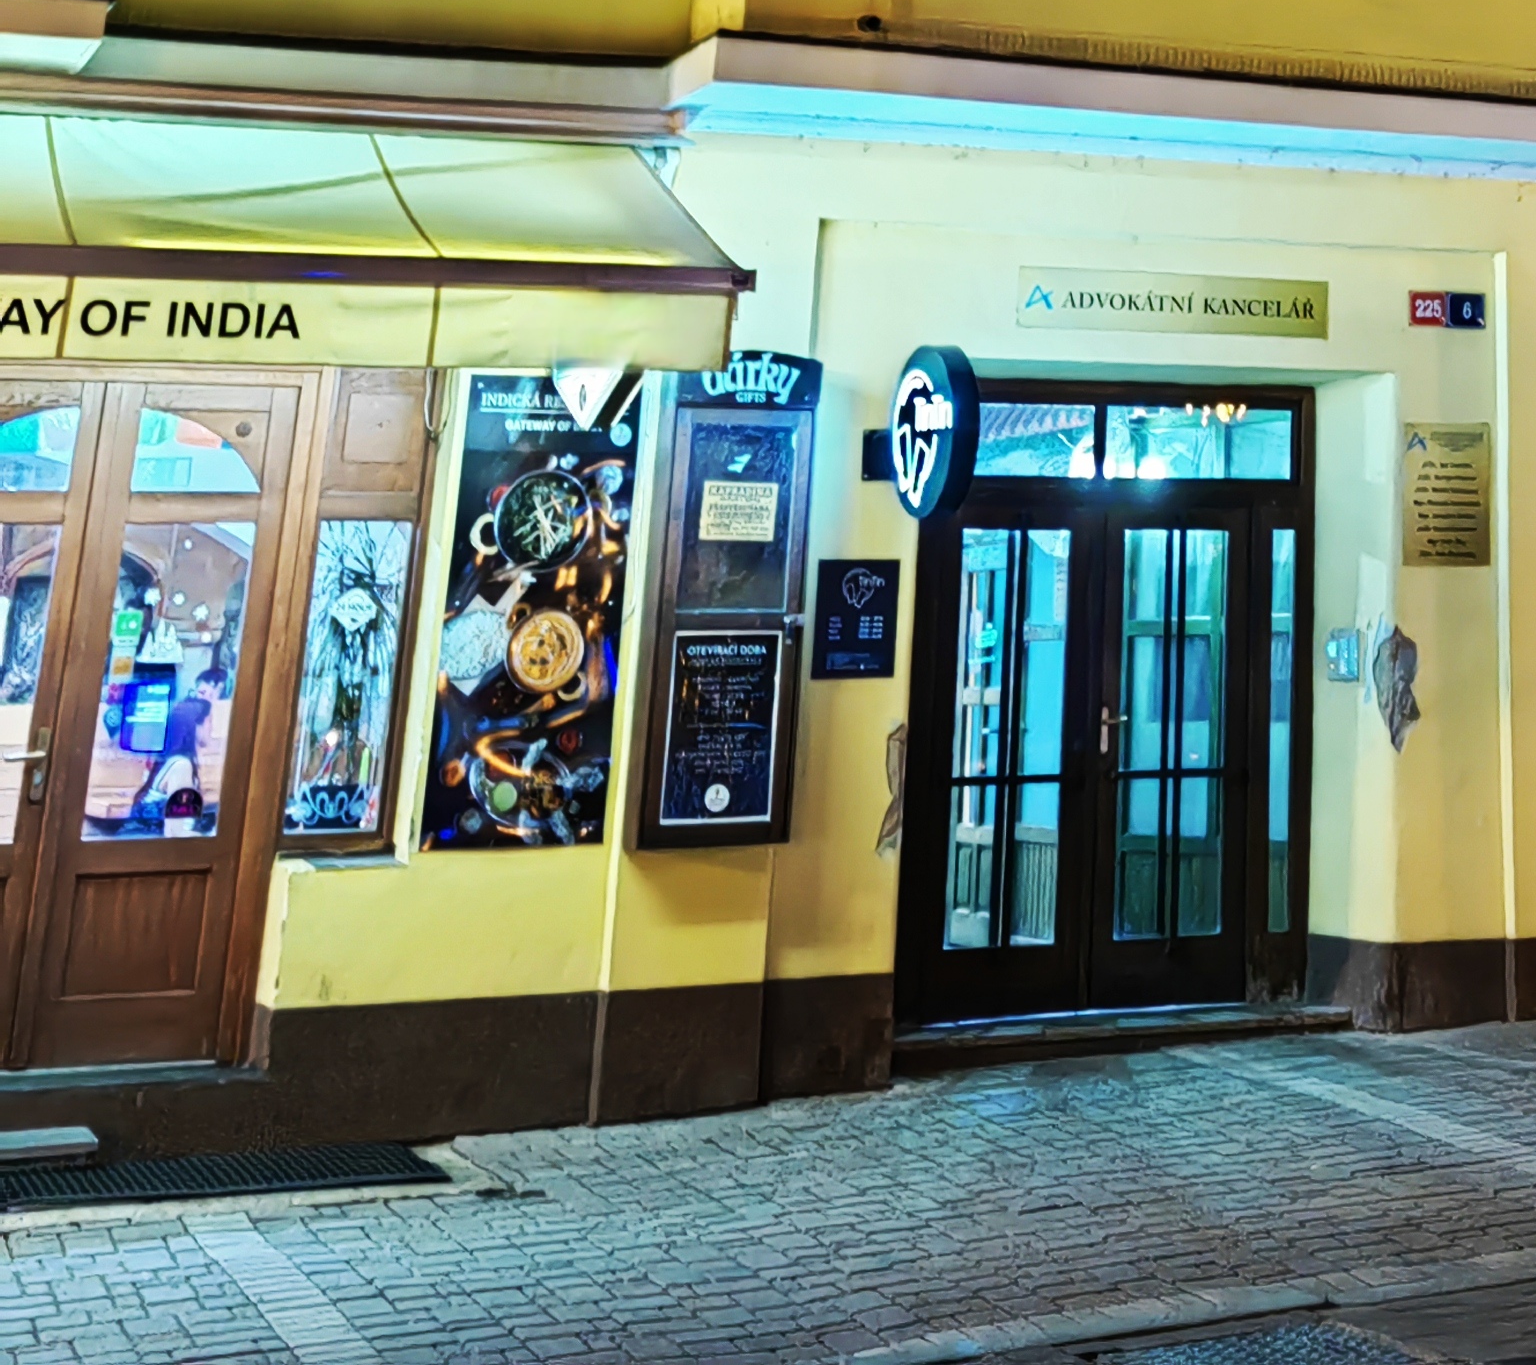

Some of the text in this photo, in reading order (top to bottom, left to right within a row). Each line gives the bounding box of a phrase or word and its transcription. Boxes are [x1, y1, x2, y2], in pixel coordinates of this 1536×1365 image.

[1062, 290, 1195, 314] ADVOKÁTNÍ
[1203, 296, 1316, 320] KANCELÁŘ
[1415, 299, 1472, 319] 225 6
[0, 298, 300, 339] AY OF INDIA
[481, 390, 541, 408] INDICKÁ
[735, 391, 767, 403] GIFTS
[504, 419, 556, 432] GATEWAY
[557, 420, 572, 432] OF
